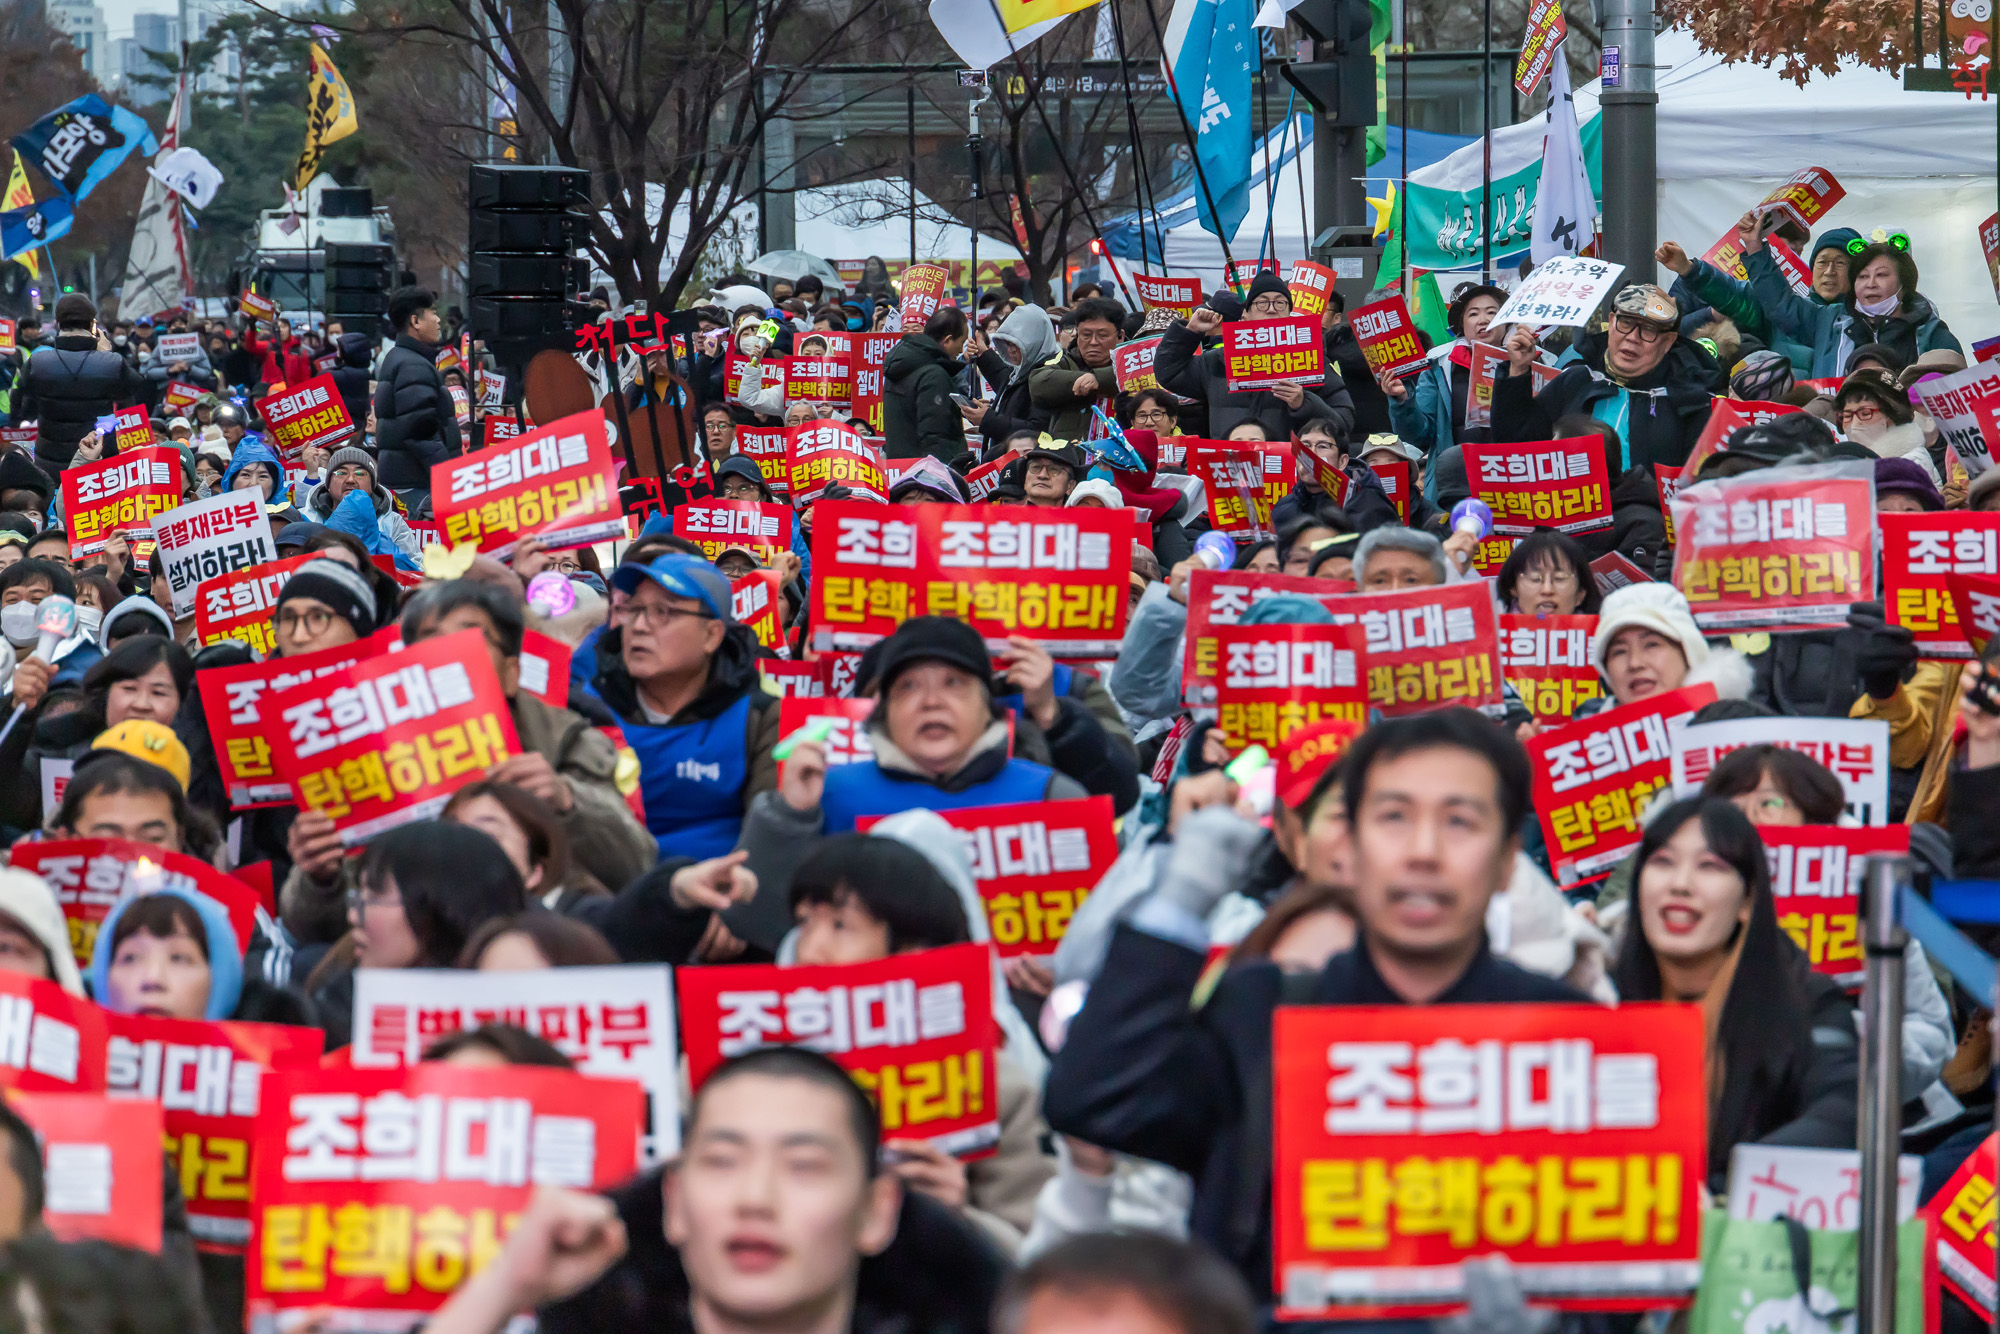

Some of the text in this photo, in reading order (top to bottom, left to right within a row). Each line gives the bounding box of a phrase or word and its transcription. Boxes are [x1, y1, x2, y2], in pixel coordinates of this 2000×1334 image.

[1138, 280, 1193, 303] 조희대를
[1234, 324, 1312, 350] 조희대를
[1353, 309, 1402, 341] 조희대를
[792, 361, 849, 378] 조희대를
[863, 339, 902, 365] 내란
[1230, 349, 1319, 378] 탄핵하라!
[1362, 332, 1418, 369] 탄핵하라!
[265, 386, 330, 423] 조희대를
[788, 382, 851, 398] 탄핵하라!
[274, 404, 346, 447] 탄핵하라!
[76, 457, 171, 505] 조희대를
[450, 433, 589, 503] 조희대를
[790, 456, 885, 493] 탄핵하라!
[1478, 451, 1591, 484] 조희대를
[157, 500, 260, 552] 특별재판부
[446, 472, 611, 552] 탄핵하라!
[686, 507, 779, 537] 조희대를
[1478, 483, 1603, 522] 탄핵하라!
[1693, 497, 1848, 547] 조희대를
[939, 519, 1111, 570] 조희대를
[822, 576, 916, 625] 탄핵
[1682, 550, 1861, 602] 탄핵하라!
[926, 582, 1119, 630] 탄핵하라!
[1336, 603, 1477, 655] 희대를
[1225, 640, 1357, 689] 조희대를
[282, 662, 475, 760] 조희대를
[297, 712, 510, 822] 탄핵하라!
[1549, 773, 1672, 854] 탄핵
[717, 977, 968, 1058] 조희대를
[1324, 1037, 1660, 1135] 조희대를
[281, 1090, 597, 1188] 조희대를
[1302, 1154, 1682, 1251] 탄핵하라!
[261, 1202, 522, 1294] 탄핵하
